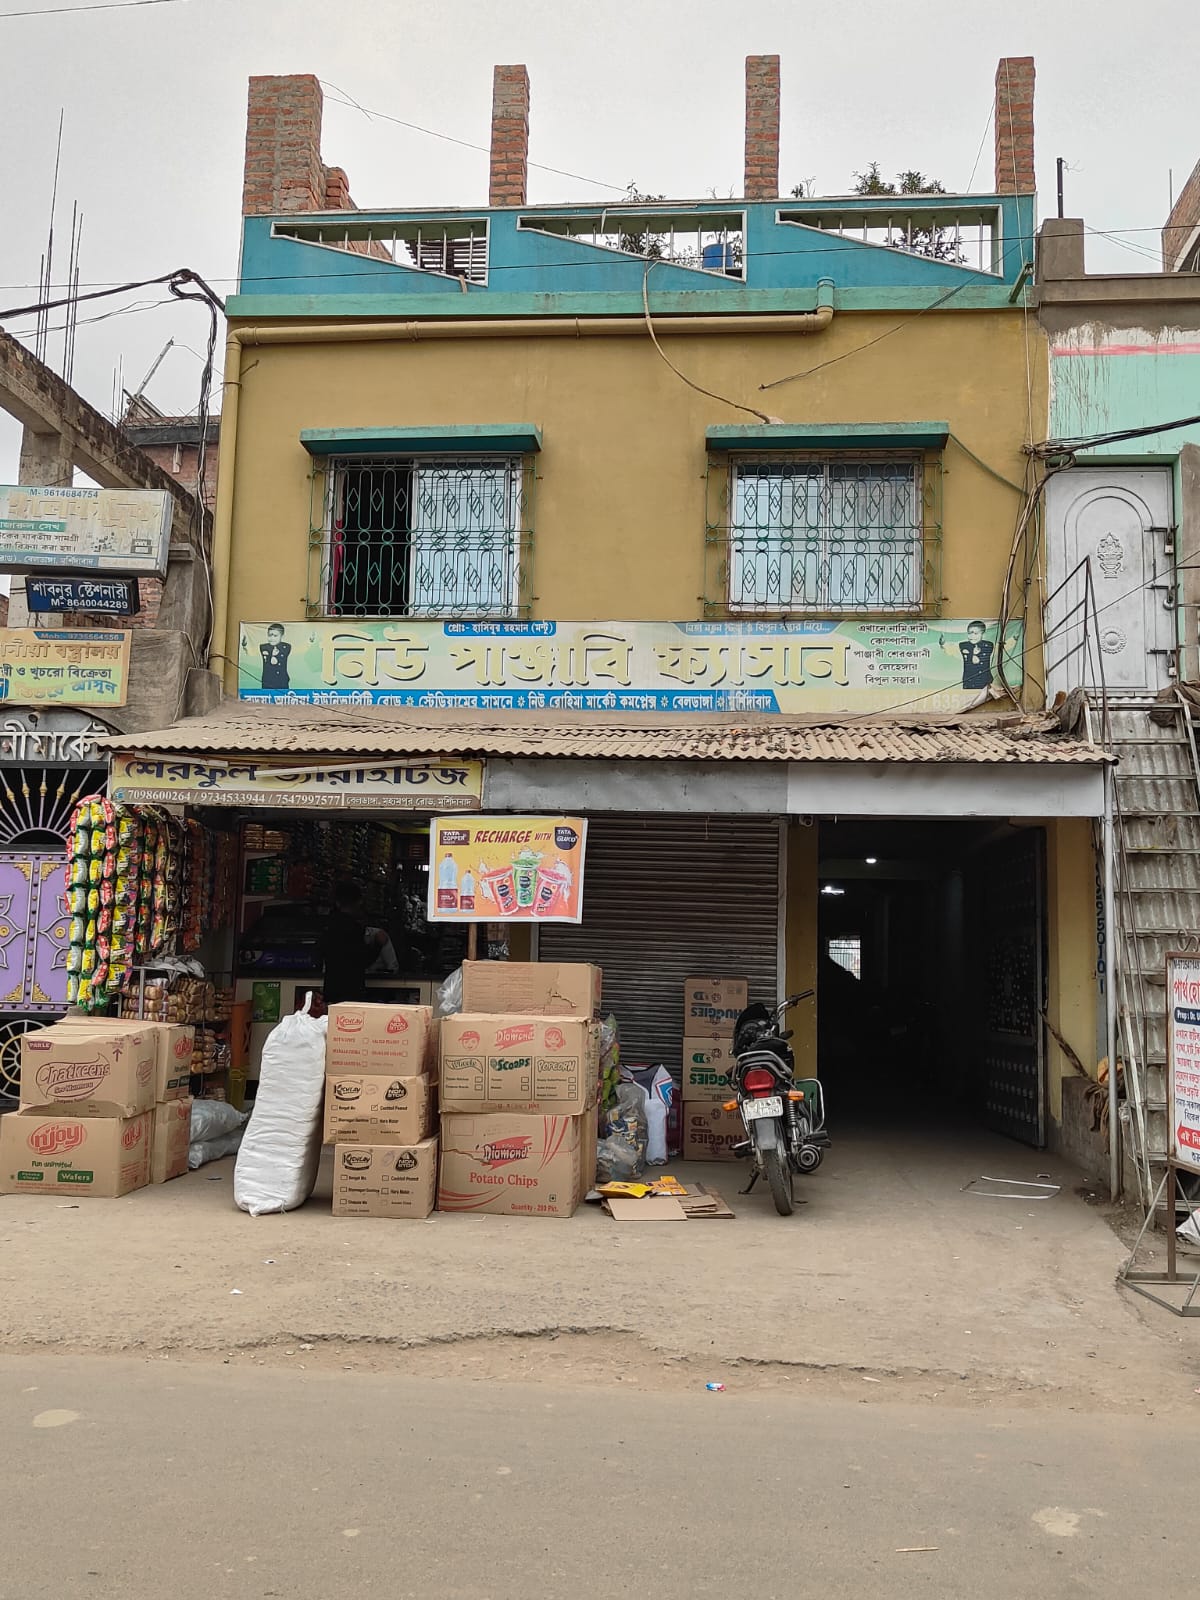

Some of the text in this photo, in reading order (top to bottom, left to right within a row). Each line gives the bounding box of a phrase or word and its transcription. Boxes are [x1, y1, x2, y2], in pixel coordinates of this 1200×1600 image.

[44, 489, 98, 498] 9614684754
[67, 599, 128, 609] 8640044289
[503, 623, 528, 633] রহমান
[322, 627, 429, 687] নিউ
[449, 630, 633, 687] পাঞ্জাবি
[16, 667, 26, 676] ও
[30, 667, 64, 680] খুচরো
[68, 665, 112, 679] বিক্রেতা
[481, 696, 513, 709] সামনে
[528, 692, 546, 709] নিউ
[128, 789, 191, 801] 7098600264
[200, 791, 265, 803] 9734533944
[275, 794, 340, 805] 7547997577
[474, 830, 532, 844] RECHARGE
[537, 1060, 577, 1073] POPCORN
[690, 1074, 729, 1086] GGIES
[484, 1144, 528, 1161] Diamond
[61, 1173, 91, 1182] Wafers
[469, 1172, 539, 1188] Potato Chips
